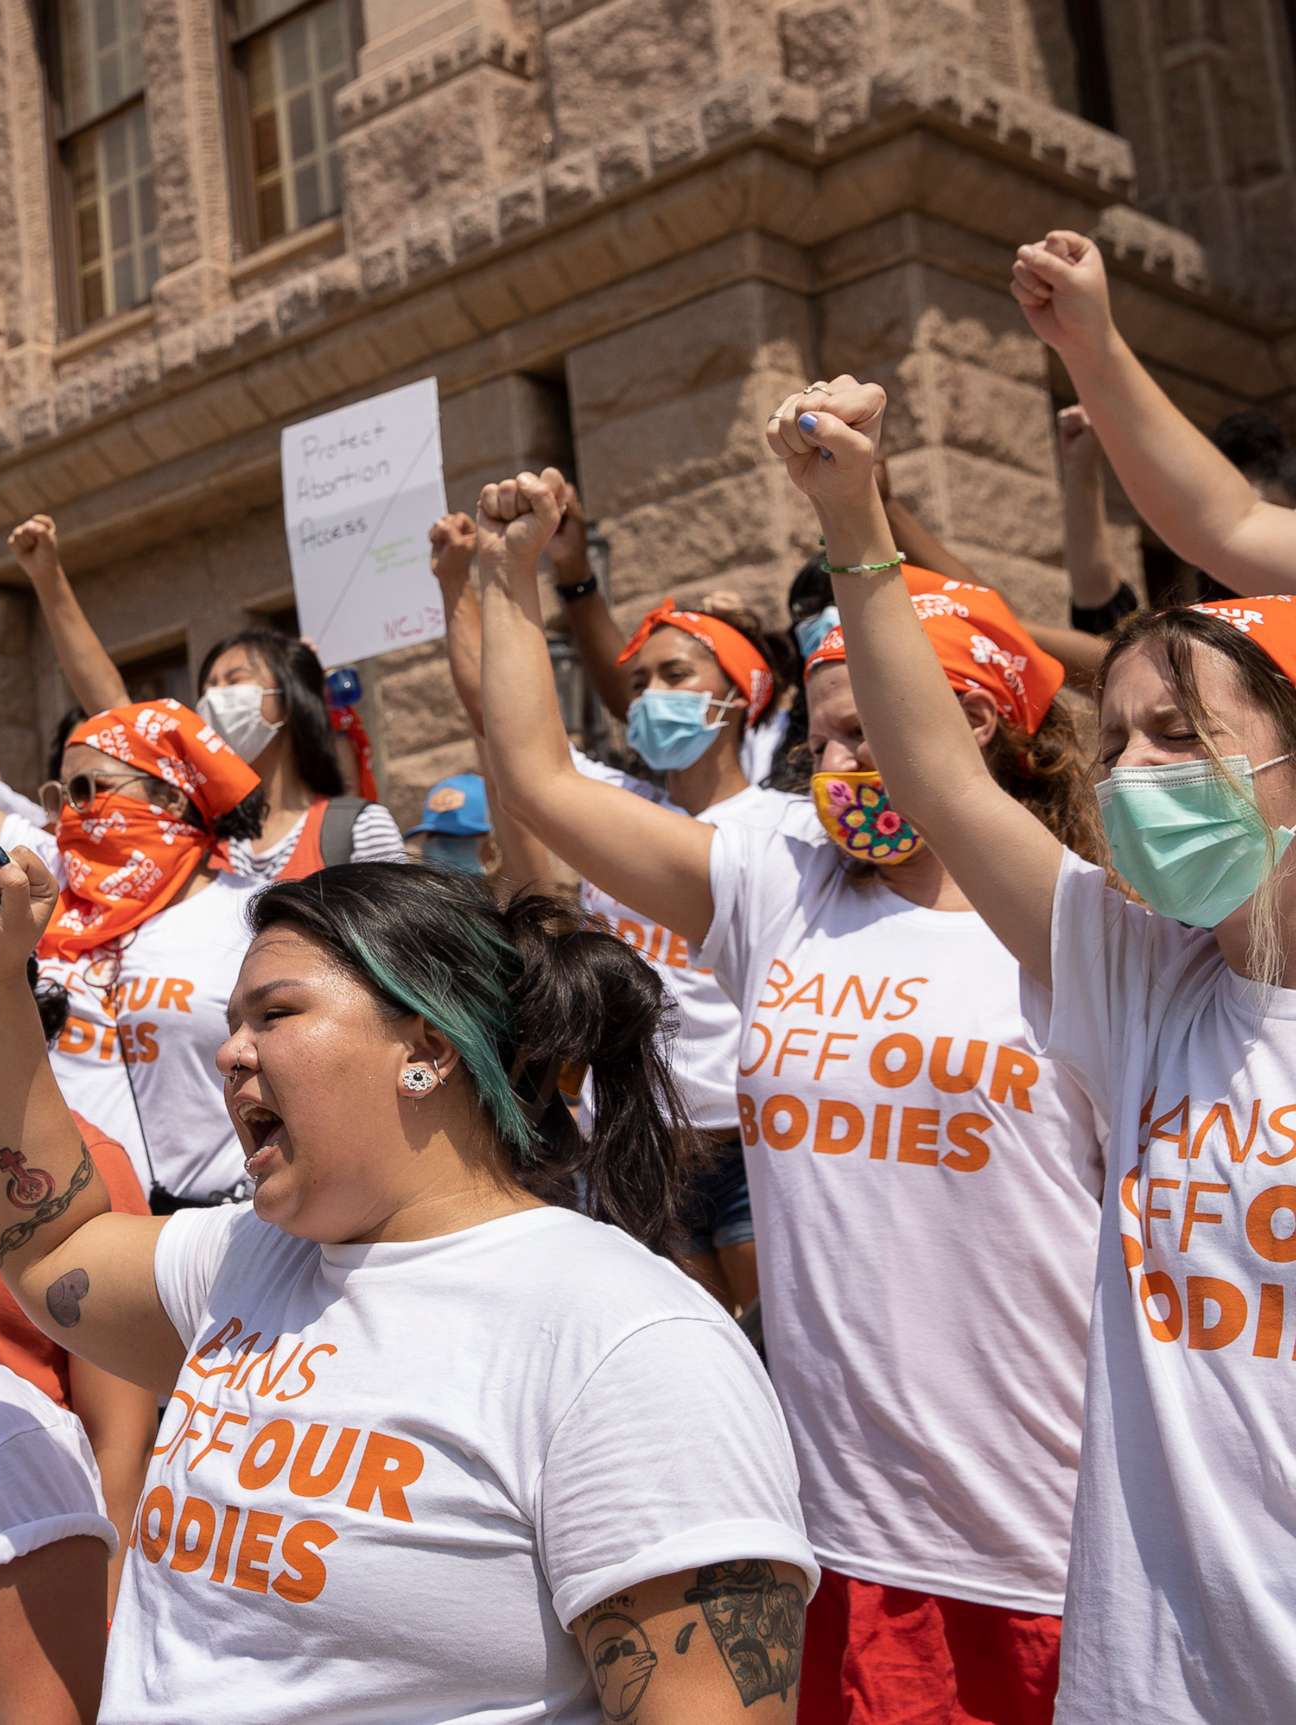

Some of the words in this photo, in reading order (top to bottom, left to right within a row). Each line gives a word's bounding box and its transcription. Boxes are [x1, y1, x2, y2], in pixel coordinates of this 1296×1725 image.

[300, 420, 387, 464] Protect
[296, 460, 390, 502] Abortion
[298, 517, 368, 552] Access
[589, 911, 713, 975] DIE
[758, 959, 929, 1021] BANS
[57, 1014, 161, 1064] DIES
[739, 1022, 858, 1081] OFF
[869, 1032, 1040, 1113] OUR
[736, 1093, 994, 1173] BODIES
[186, 1316, 338, 1402] BANS
[238, 1419, 425, 1523] OUR
[129, 1484, 340, 1605] ODIES
